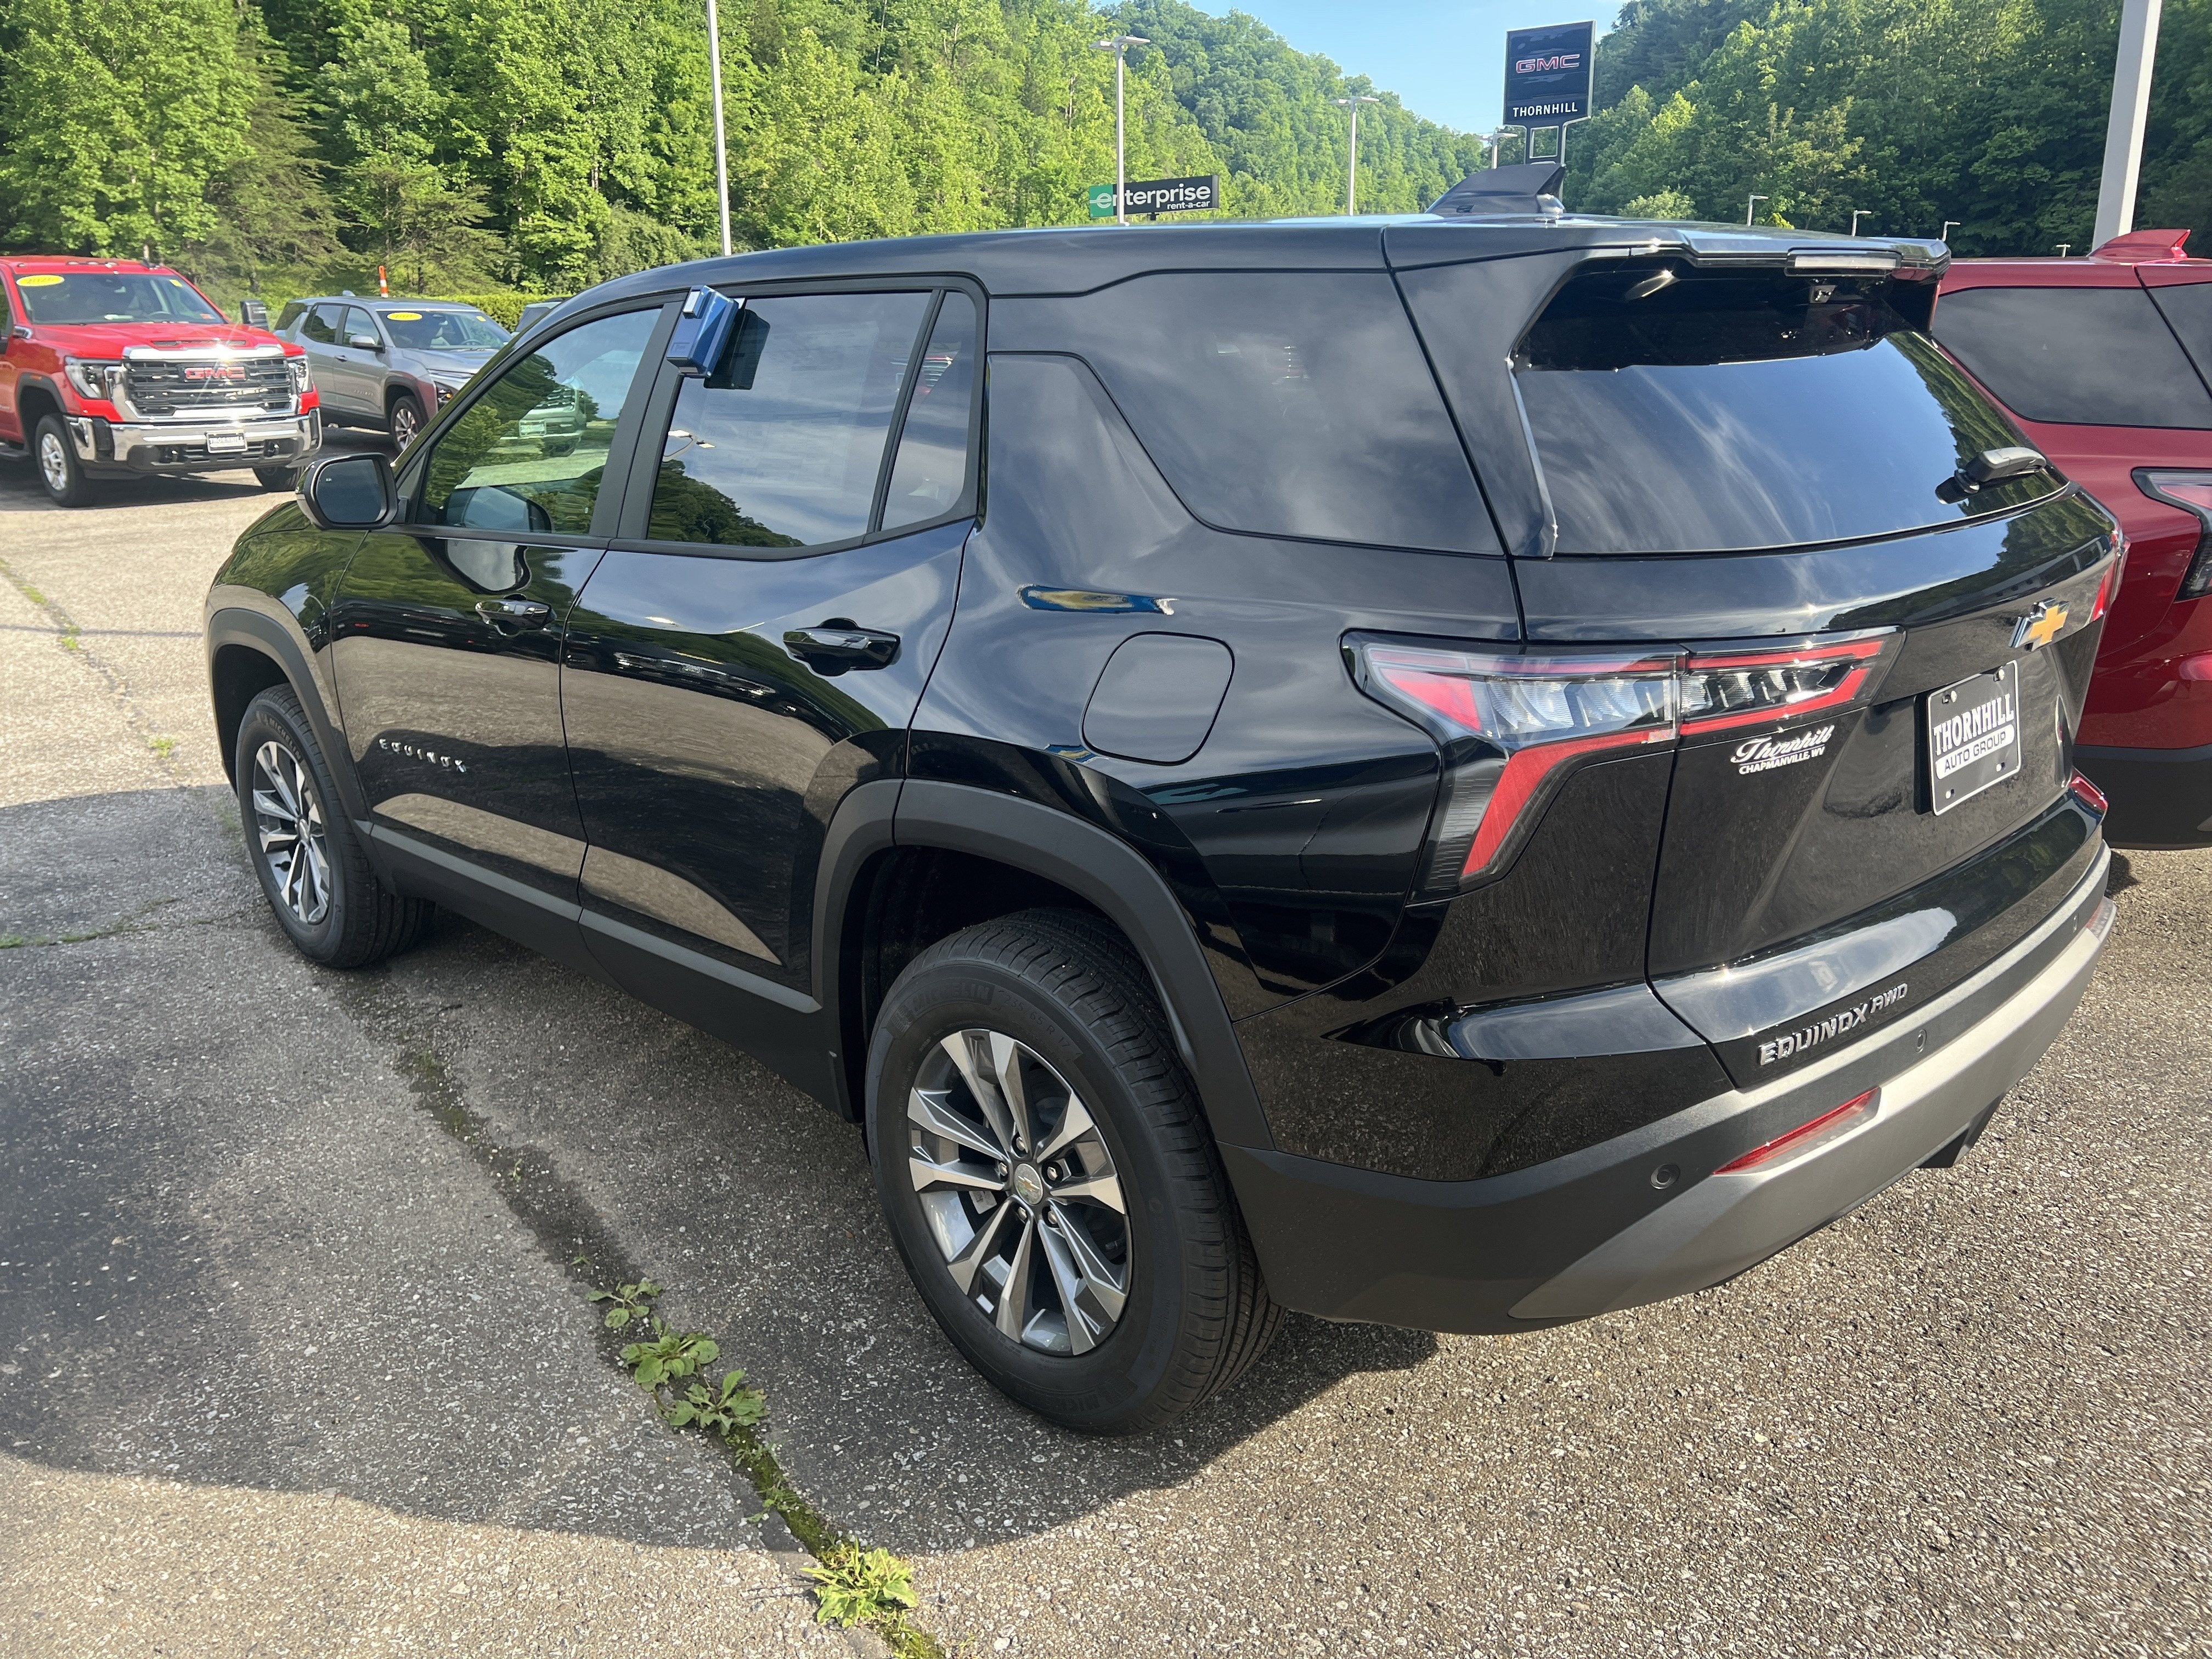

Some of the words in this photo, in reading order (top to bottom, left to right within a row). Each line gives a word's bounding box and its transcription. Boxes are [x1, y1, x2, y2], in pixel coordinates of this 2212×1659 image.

[1516, 54, 1581, 74] GMC
[1513, 102, 1578, 117] THORNHILL
[1167, 200, 1210, 210] rent-a-car
[184, 366, 246, 380] GMC
[1933, 693, 2015, 756] THORNHILL
[379, 738, 467, 773] EQUINOX
[1730, 725, 1835, 763] Thornhill
[1811, 746, 1825, 758] WV
[1944, 749, 1970, 773] AUTO
[1973, 731, 2006, 757] GROUP
[1758, 1003, 1868, 1066] EQUINOX
[1870, 983, 1908, 1013] AWD
[1046, 1025, 1056, 1035] R
[1057, 1036, 1070, 1048] 17
